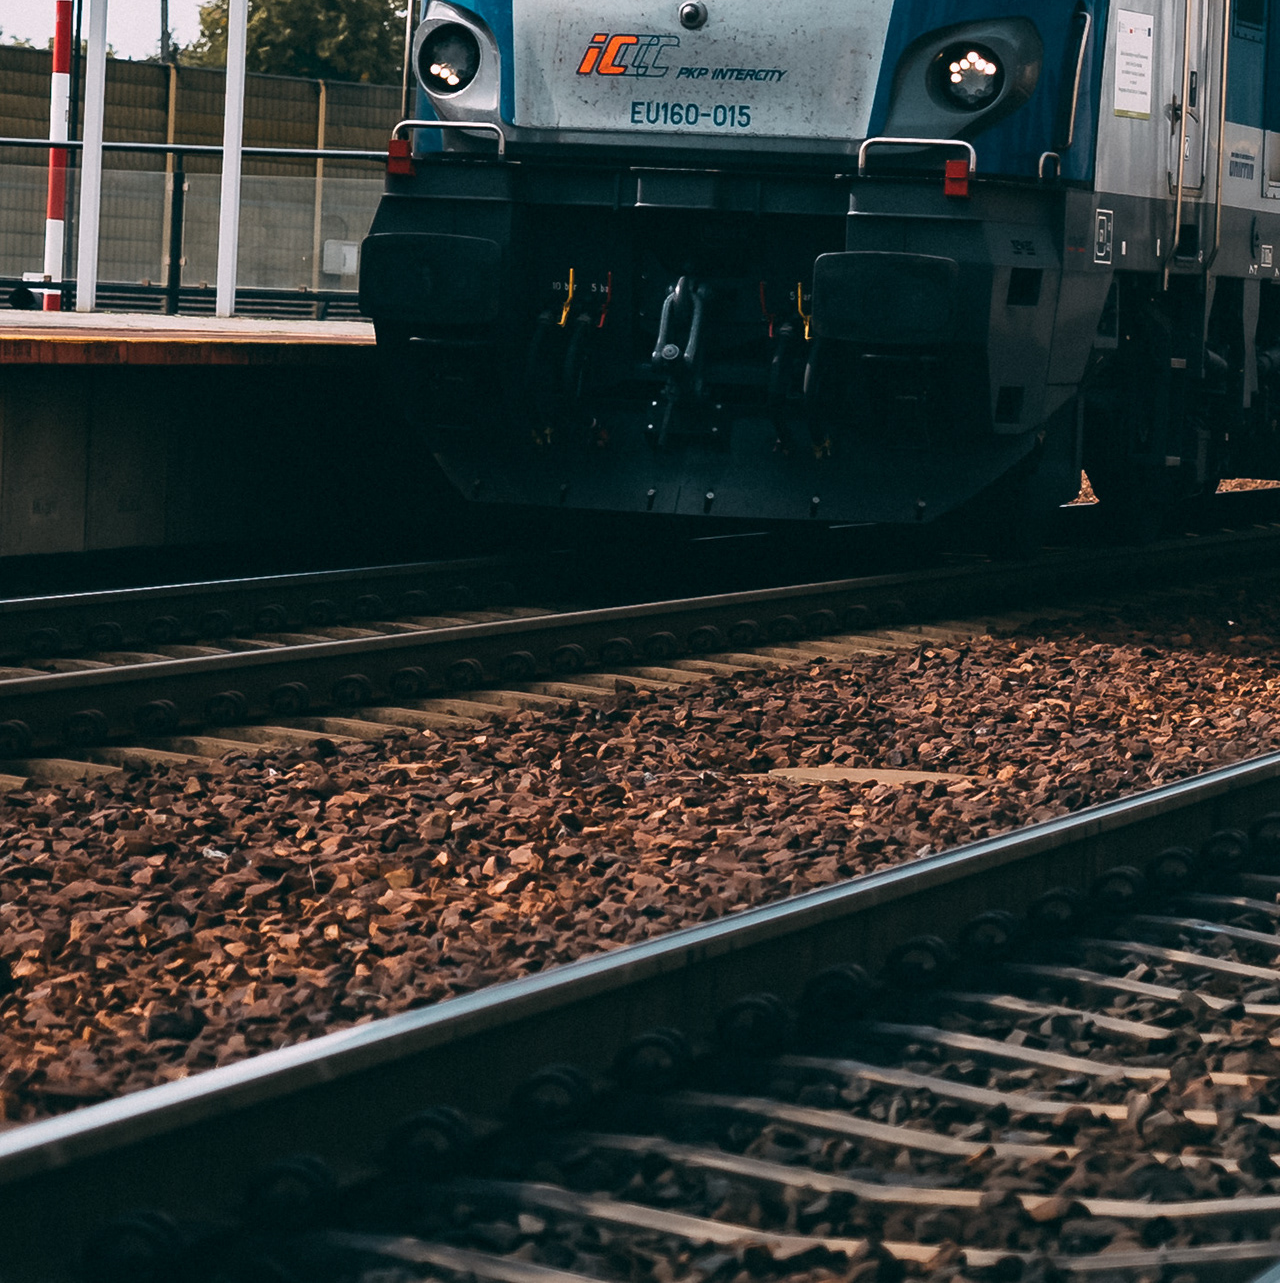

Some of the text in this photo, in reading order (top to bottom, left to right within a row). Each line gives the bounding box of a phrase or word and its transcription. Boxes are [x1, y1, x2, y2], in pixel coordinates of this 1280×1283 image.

[676, 66, 788, 82] PKP INTERCITY
[631, 102, 751, 128] EU160-015
[552, 281, 578, 291] 10 br
[591, 283, 597, 292] 5
[789, 291, 796, 301] 5
